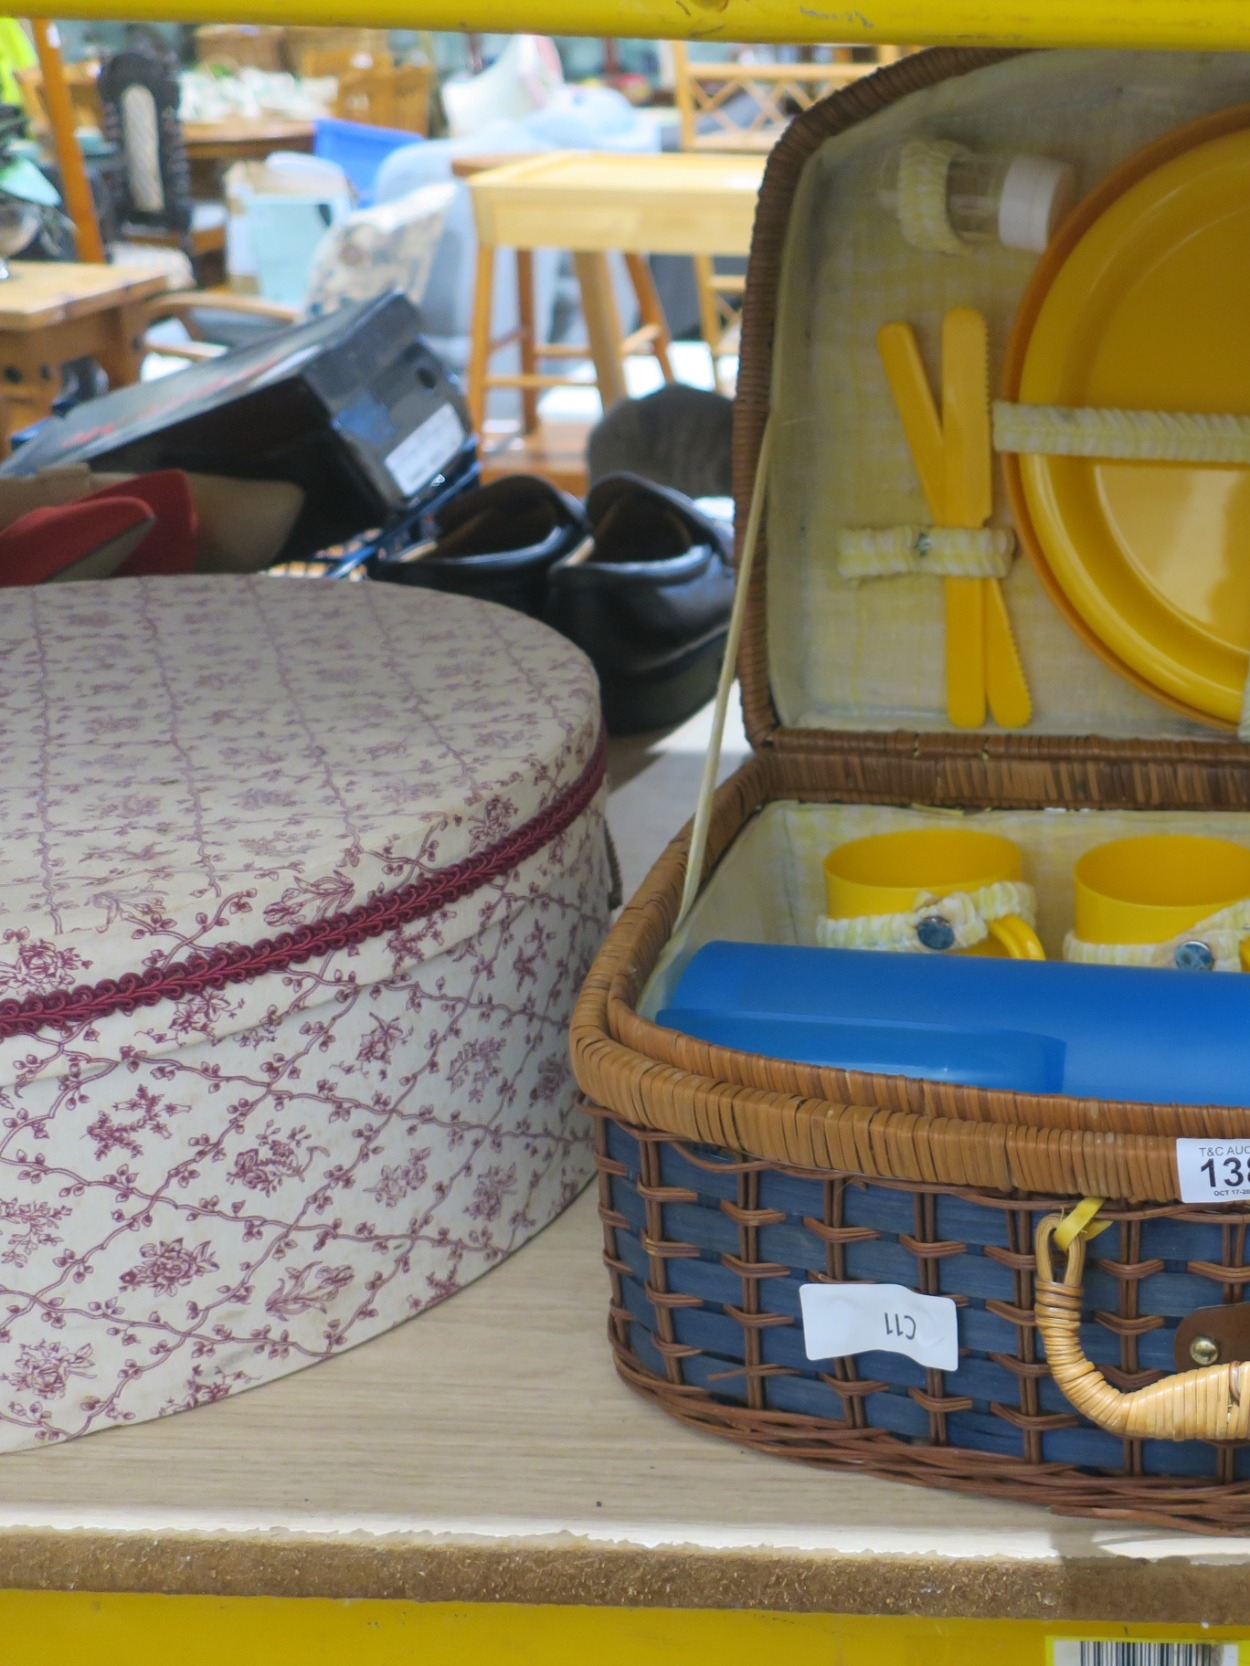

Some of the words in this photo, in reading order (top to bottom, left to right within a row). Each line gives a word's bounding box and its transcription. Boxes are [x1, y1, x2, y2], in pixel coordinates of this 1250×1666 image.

[1198, 1146, 1225, 1158] T&C
[1213, 1189, 1230, 1197] OCT
[883, 1311, 917, 1341] C11
